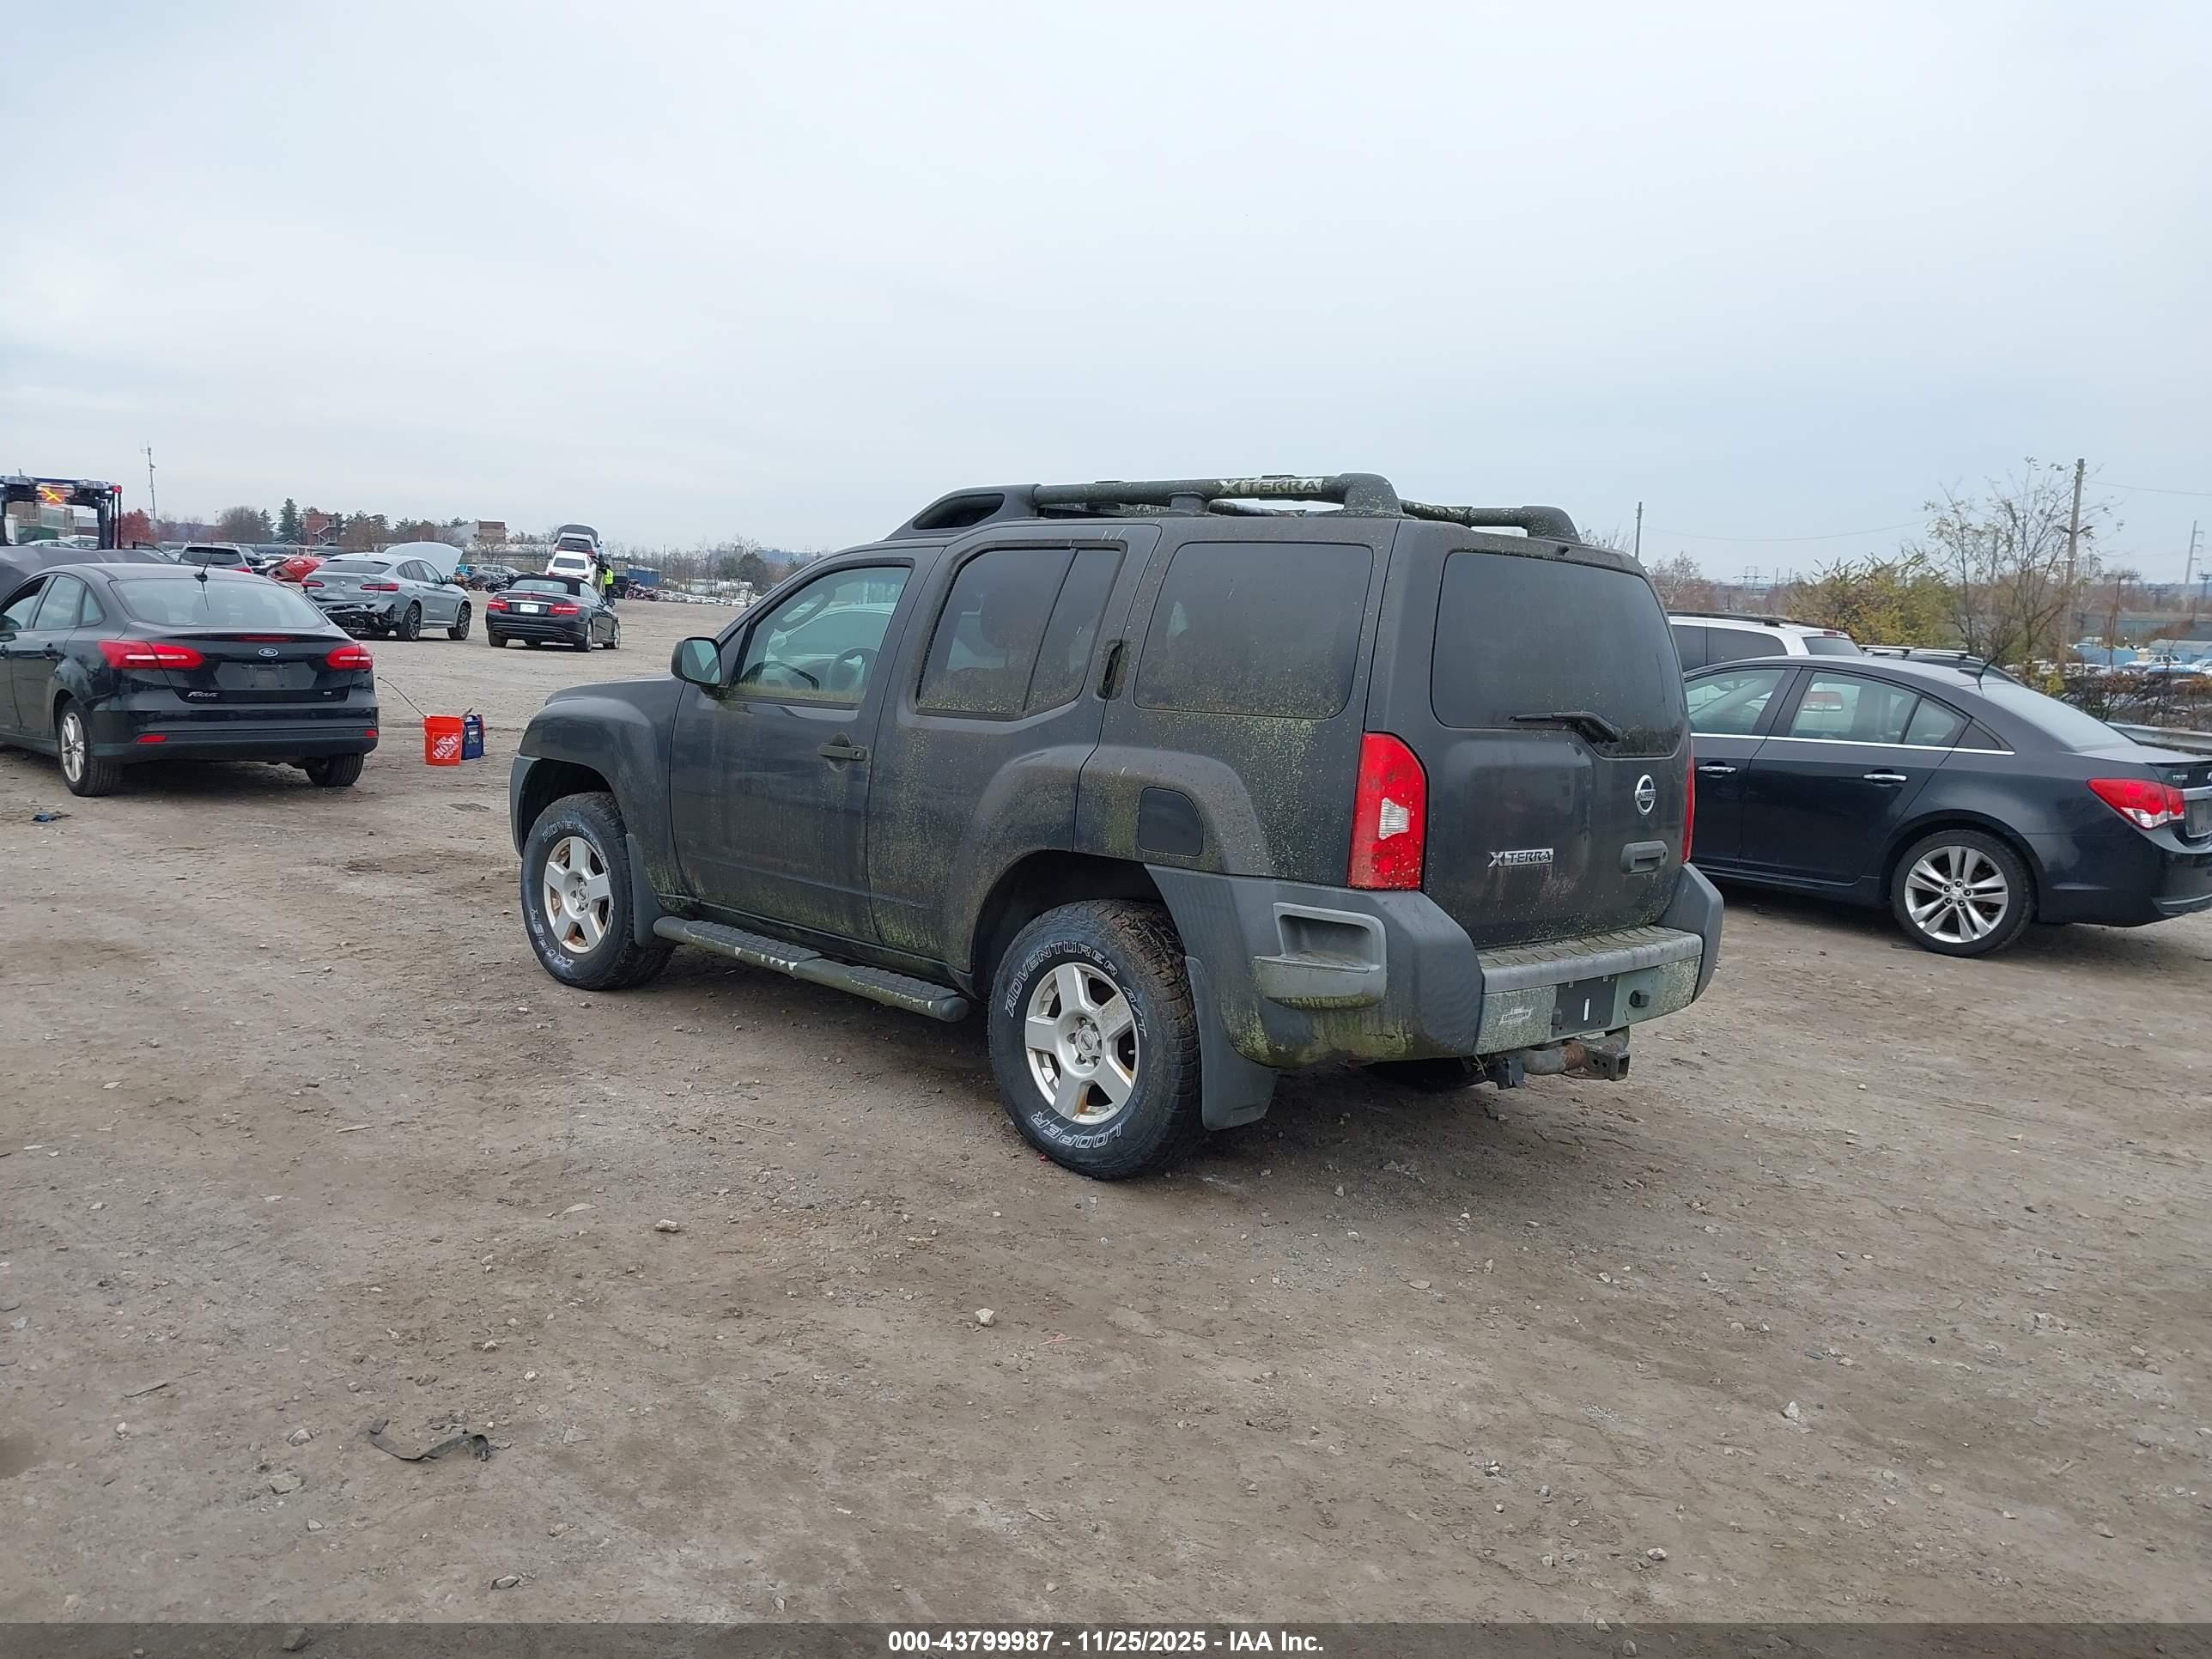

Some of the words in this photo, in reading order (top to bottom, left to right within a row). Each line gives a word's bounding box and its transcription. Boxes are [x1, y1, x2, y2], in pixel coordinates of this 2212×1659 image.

[433, 733, 459, 759] HOME
[444, 744, 459, 759] DEPOT
[1487, 848, 1553, 867] XTERRA
[1005, 941, 1118, 1018] ADVENTURER
[1123, 986, 1148, 1039] A/T
